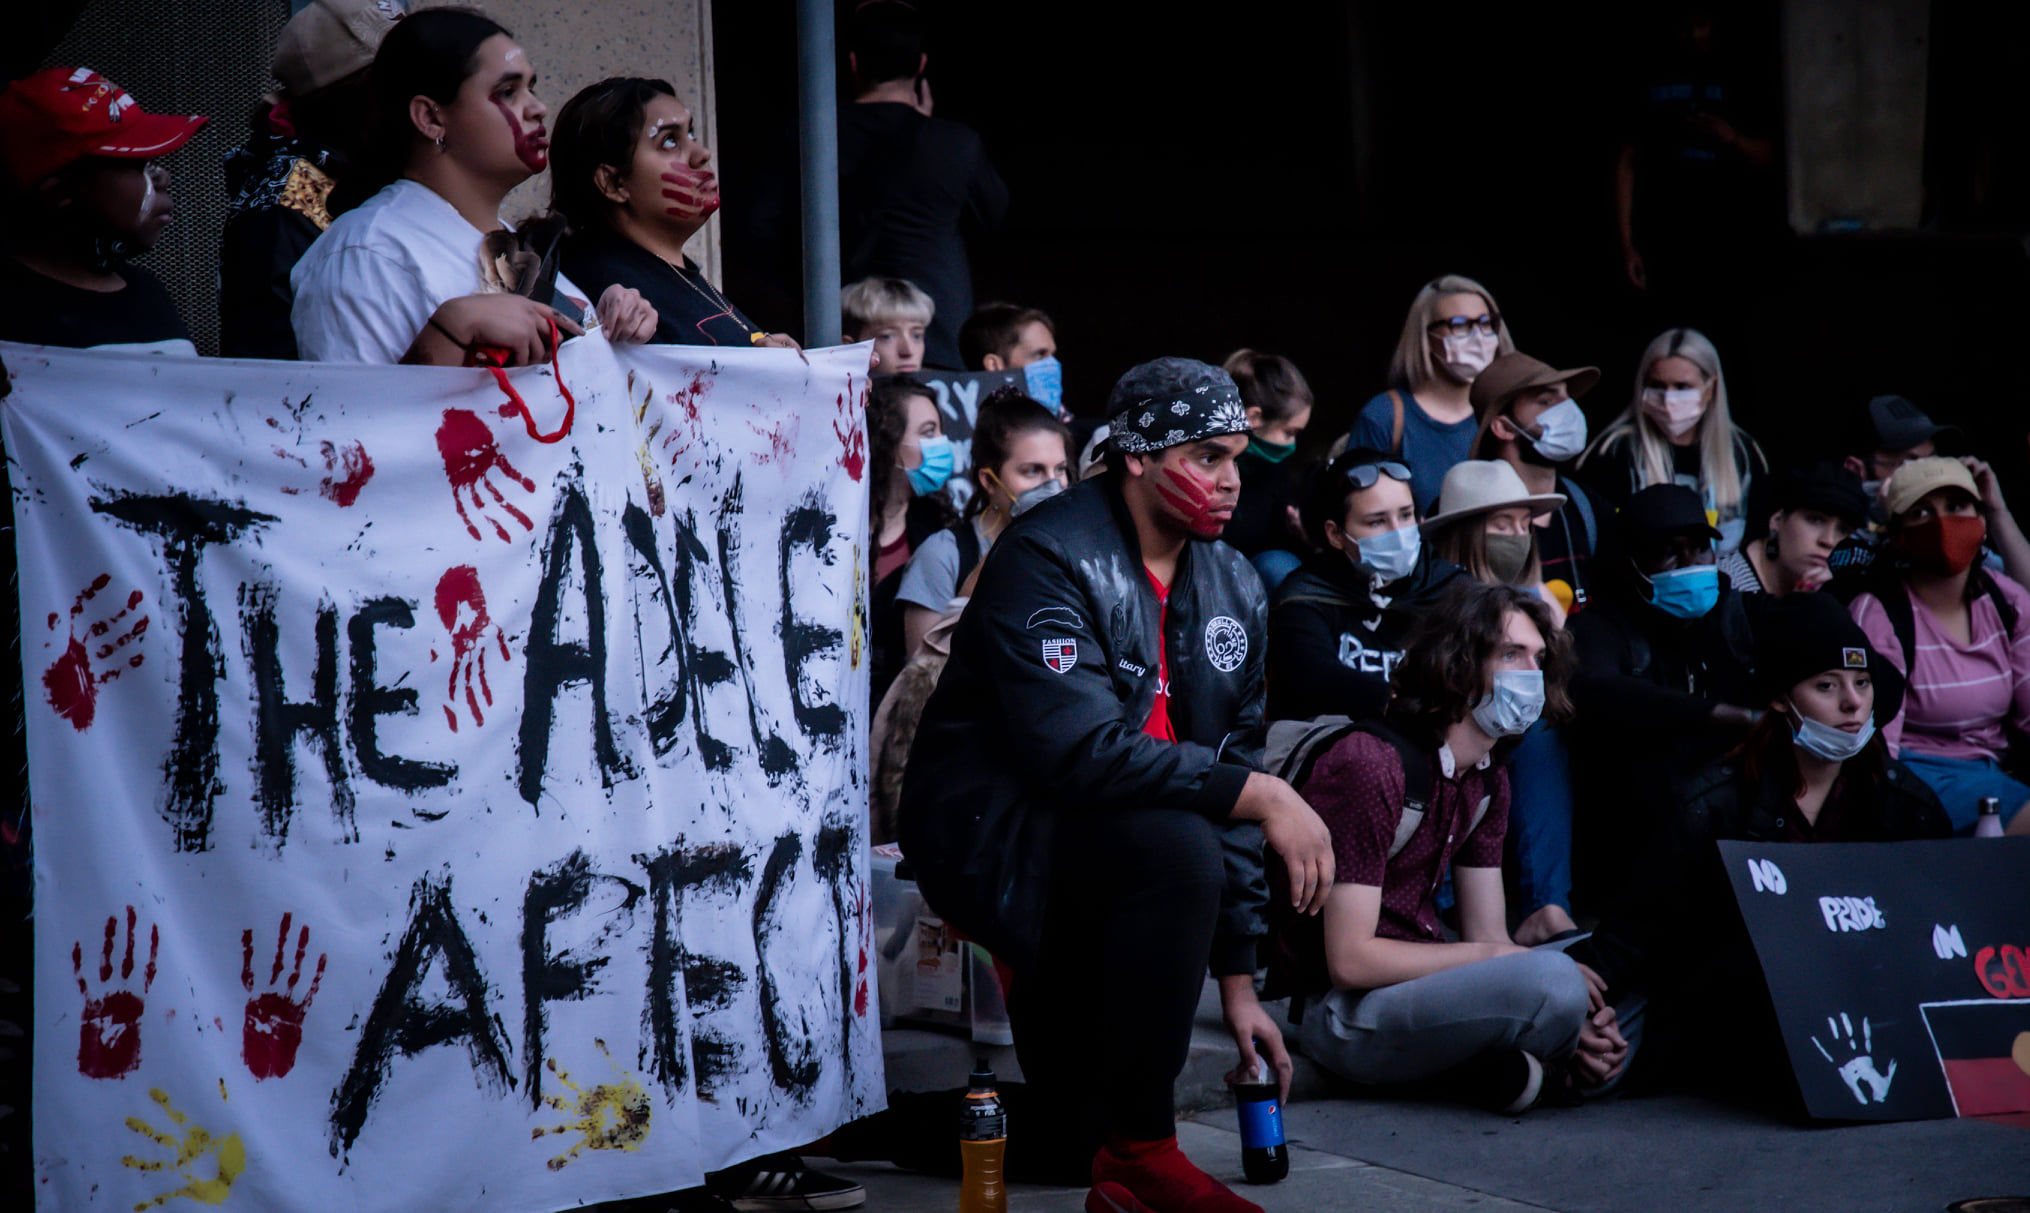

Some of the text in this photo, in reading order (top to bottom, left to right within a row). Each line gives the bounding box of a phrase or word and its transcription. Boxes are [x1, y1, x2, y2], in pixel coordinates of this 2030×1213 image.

[89, 484, 460, 854] THE
[1747, 858, 1788, 895] NO
[1818, 896, 1887, 932] PRIDE
[1932, 923, 1968, 959] IN
